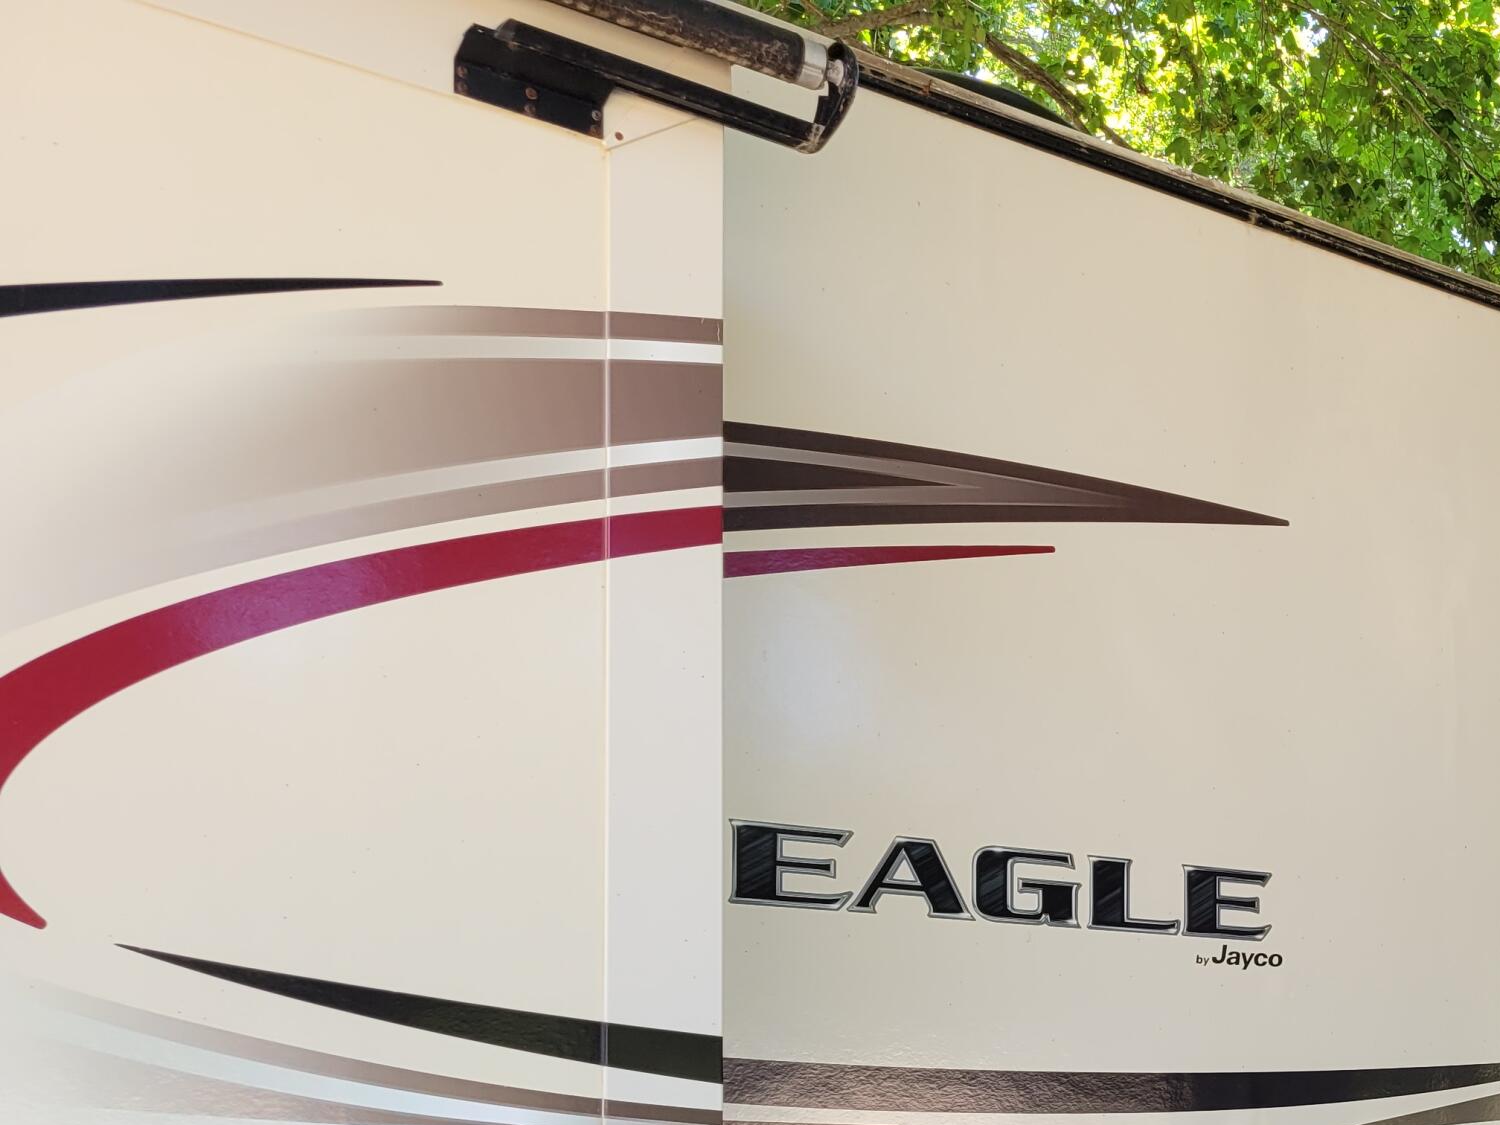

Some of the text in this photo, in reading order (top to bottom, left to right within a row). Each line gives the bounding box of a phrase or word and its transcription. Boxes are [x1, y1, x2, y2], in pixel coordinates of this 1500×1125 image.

[728, 817, 1273, 942] EAGLE
[1195, 944, 1283, 970] by Jayco
